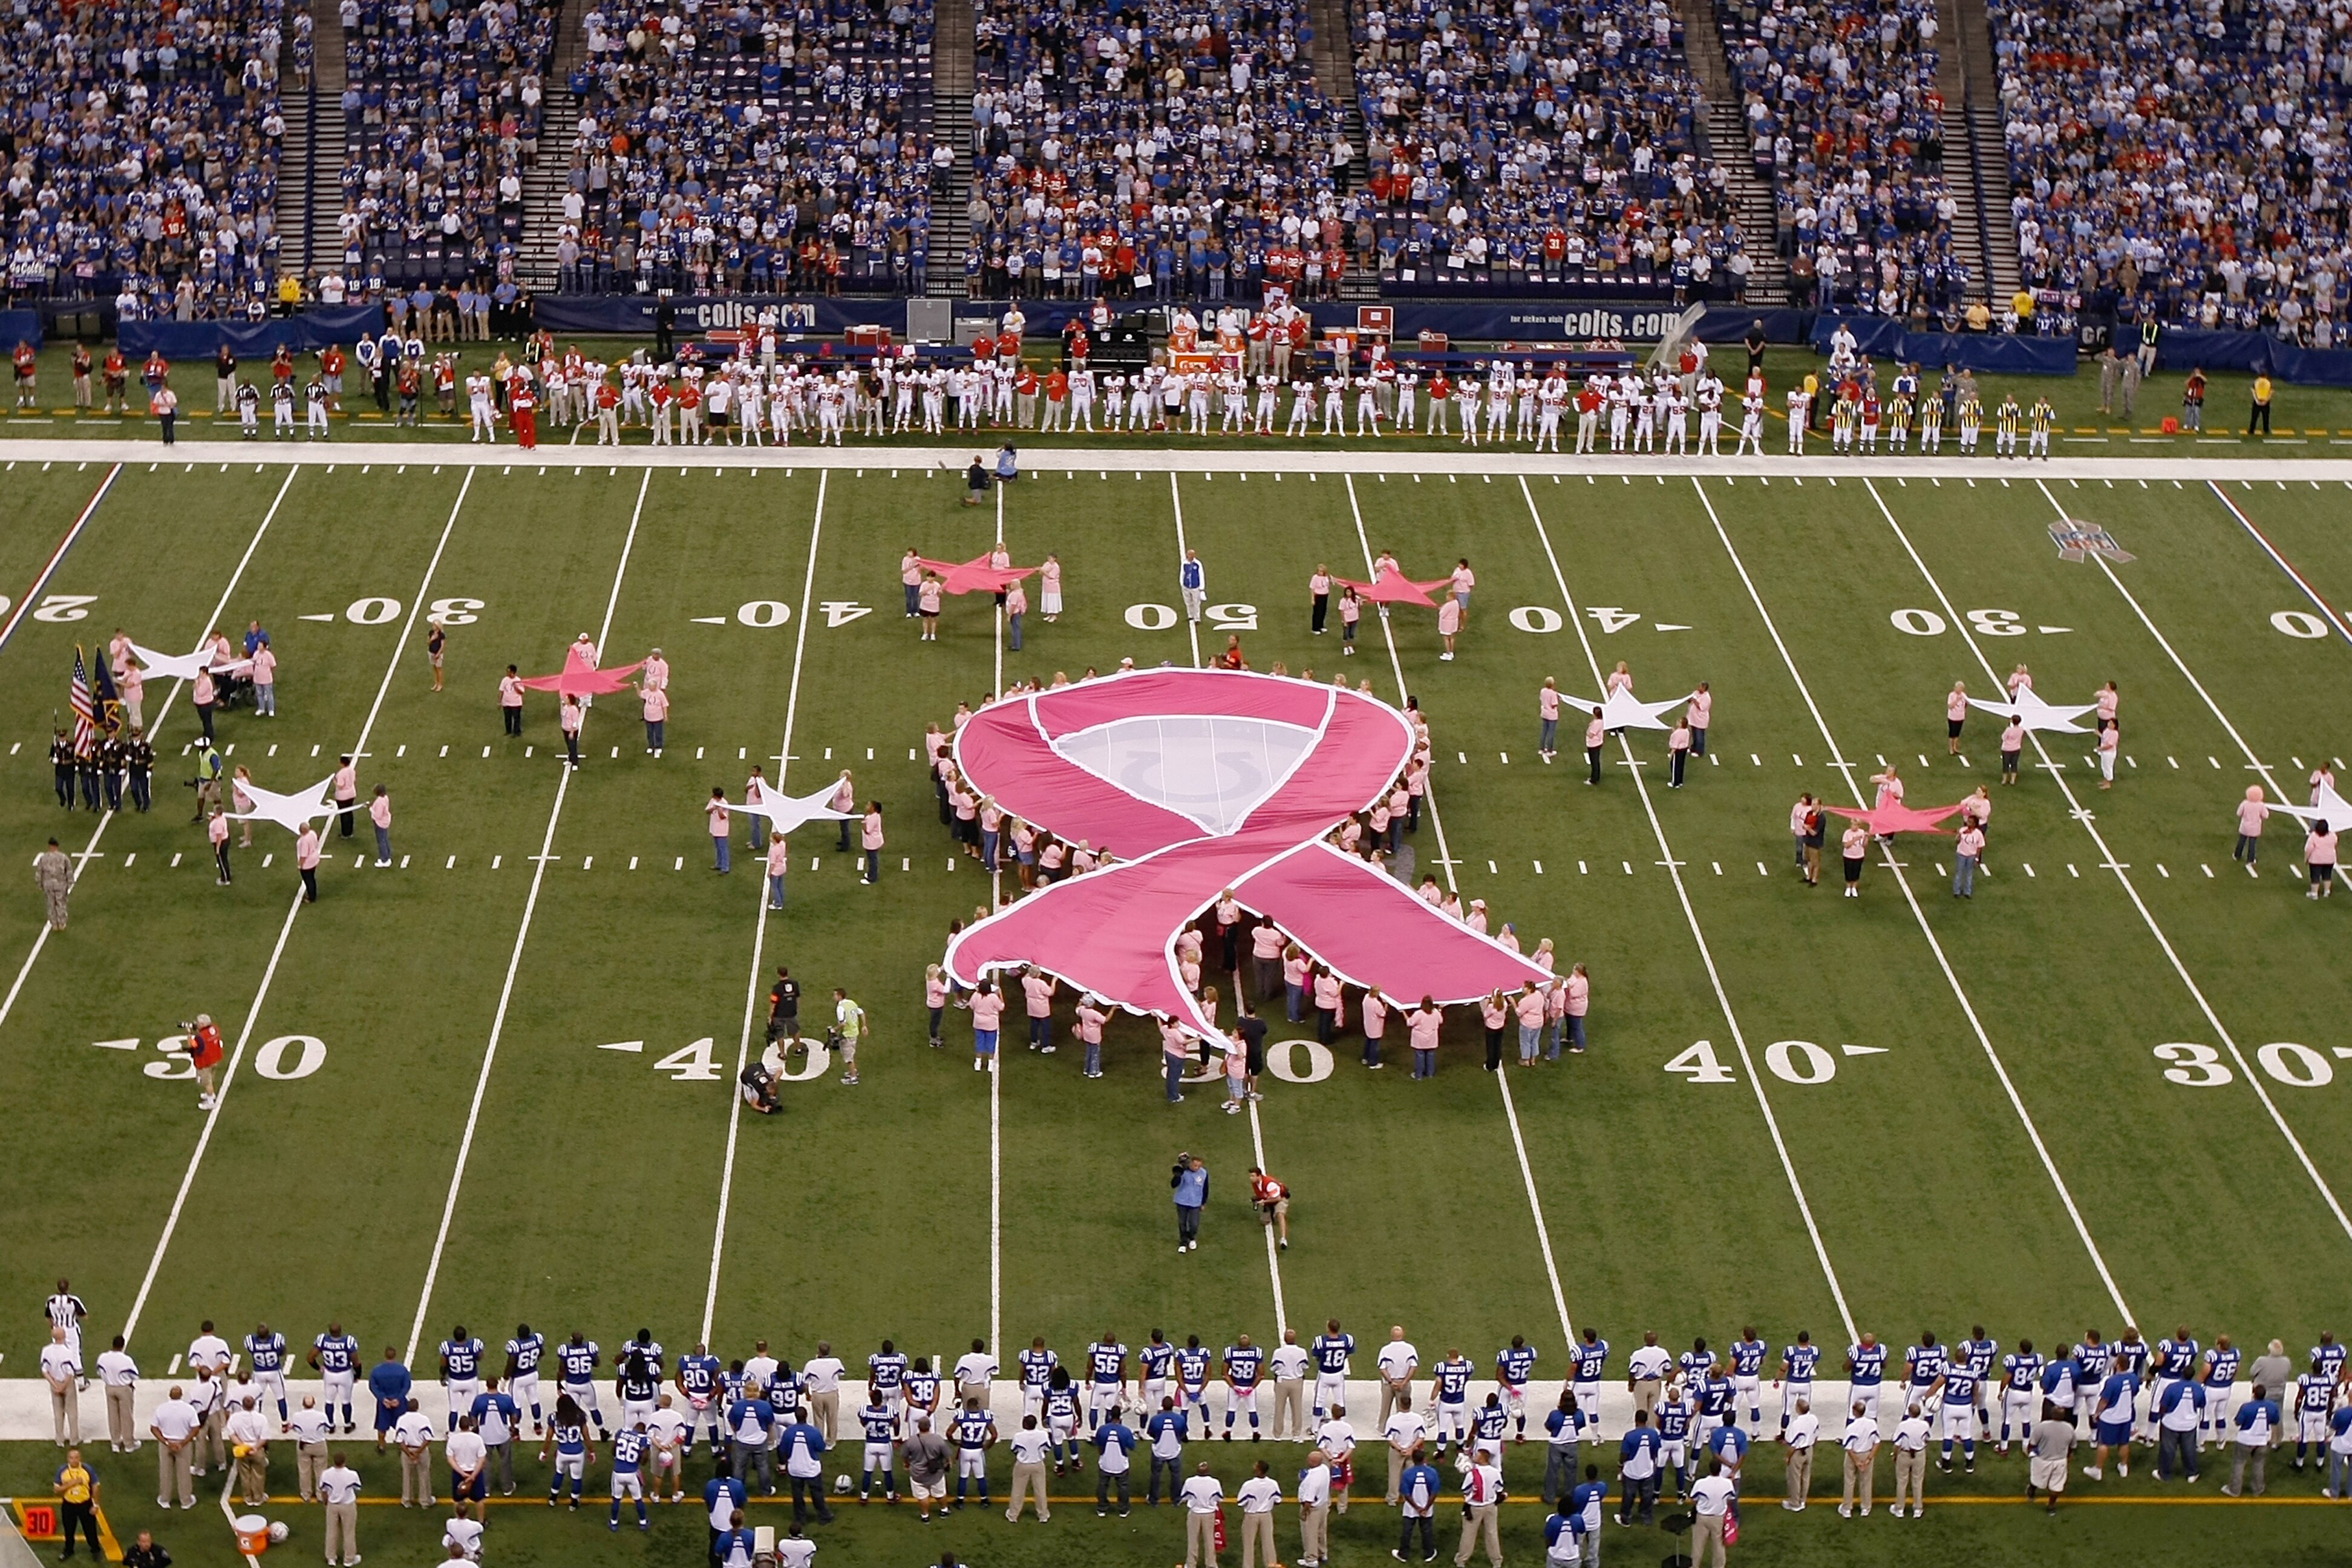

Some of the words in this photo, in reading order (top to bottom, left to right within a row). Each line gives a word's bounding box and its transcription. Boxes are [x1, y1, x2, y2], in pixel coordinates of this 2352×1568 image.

[1564, 309, 1681, 338] colts.com
[322, 1350, 348, 1367] 93
[448, 1355, 474, 1373] 95
[567, 1356, 592, 1374] 96
[1094, 1354, 1119, 1374] 56
[1153, 1357, 1166, 1375] 4
[1324, 1349, 1346, 1367] 18
[1738, 1356, 1762, 1372] 44
[2083, 1357, 2107, 1374] 78
[2169, 1354, 2192, 1373] 71
[877, 1365, 900, 1383] 23
[1025, 1365, 1050, 1382] 32
[1182, 1362, 1204, 1379] 20
[1232, 1361, 1255, 1379] 58
[1508, 1361, 1532, 1380] 52
[1581, 1359, 1601, 1377] 81
[1792, 1361, 1814, 1378] 17
[1855, 1362, 1881, 1378] 74
[1916, 1359, 1942, 1377] 63
[2013, 1366, 2038, 1387] 84
[2212, 1362, 2238, 1380] 66
[683, 1368, 708, 1387] 90
[1445, 1374, 1465, 1393] 51
[1947, 1377, 1973, 1396] 72
[773, 1390, 797, 1408] 99
[911, 1380, 935, 1401] 38
[2307, 1386, 2332, 1406] 85
[1710, 1392, 1724, 1411] 7
[865, 1421, 890, 1437] 43
[962, 1422, 987, 1442] 37
[1480, 1419, 1506, 1438] 42
[1664, 1416, 1686, 1434] 15
[615, 1438, 640, 1462] 26
[27, 1513, 51, 1534] 30
[240, 1537, 252, 1551] G
